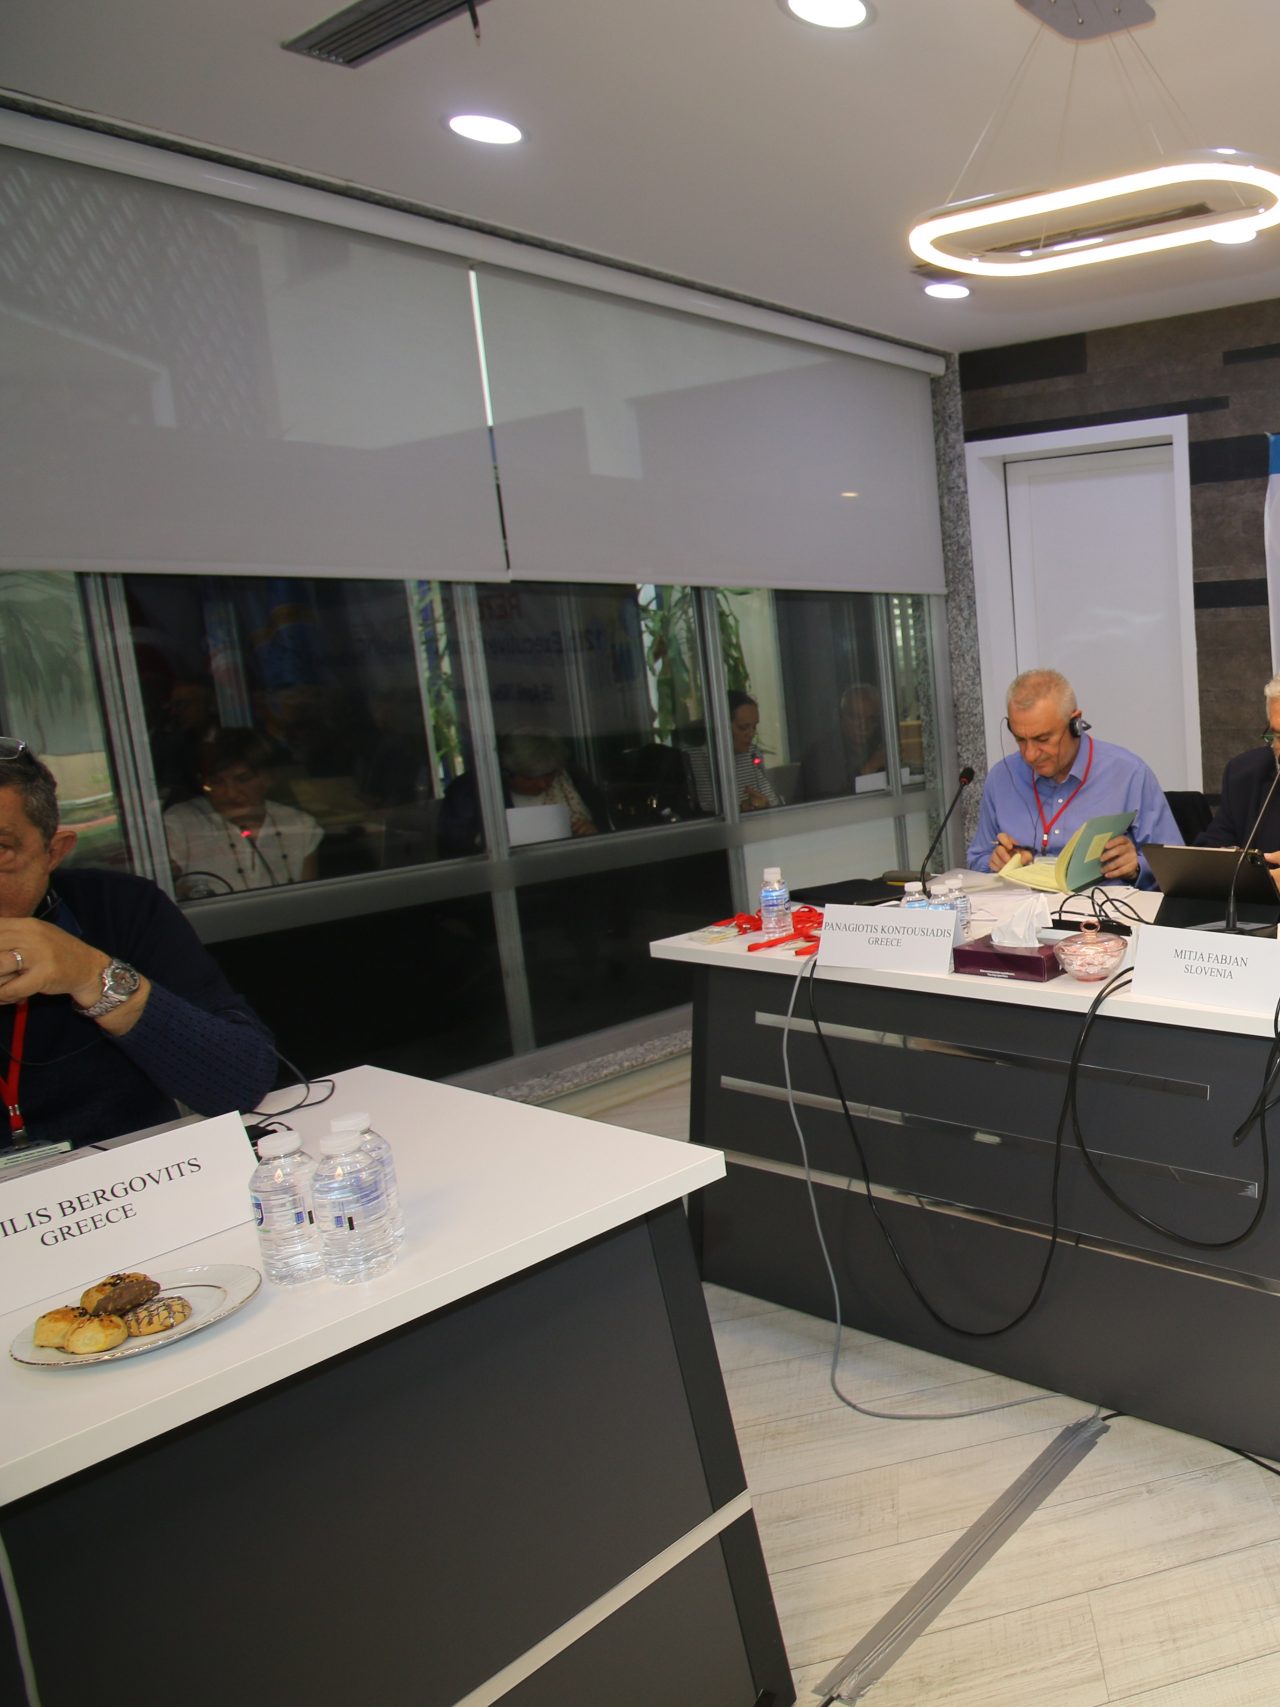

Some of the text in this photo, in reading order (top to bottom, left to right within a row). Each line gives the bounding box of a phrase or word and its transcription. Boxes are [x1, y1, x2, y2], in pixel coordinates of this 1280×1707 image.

[823, 921, 952, 938] PANAGIOTIS KONTOUSIADIS
[867, 936, 903, 947] GREECE
[1173, 948, 1249, 967] MITJA FABJAN
[1183, 963, 1234, 980] SLOVENIA
[56, 1157, 202, 1218] BERGOVITS
[40, 1202, 138, 1247] GREECE
